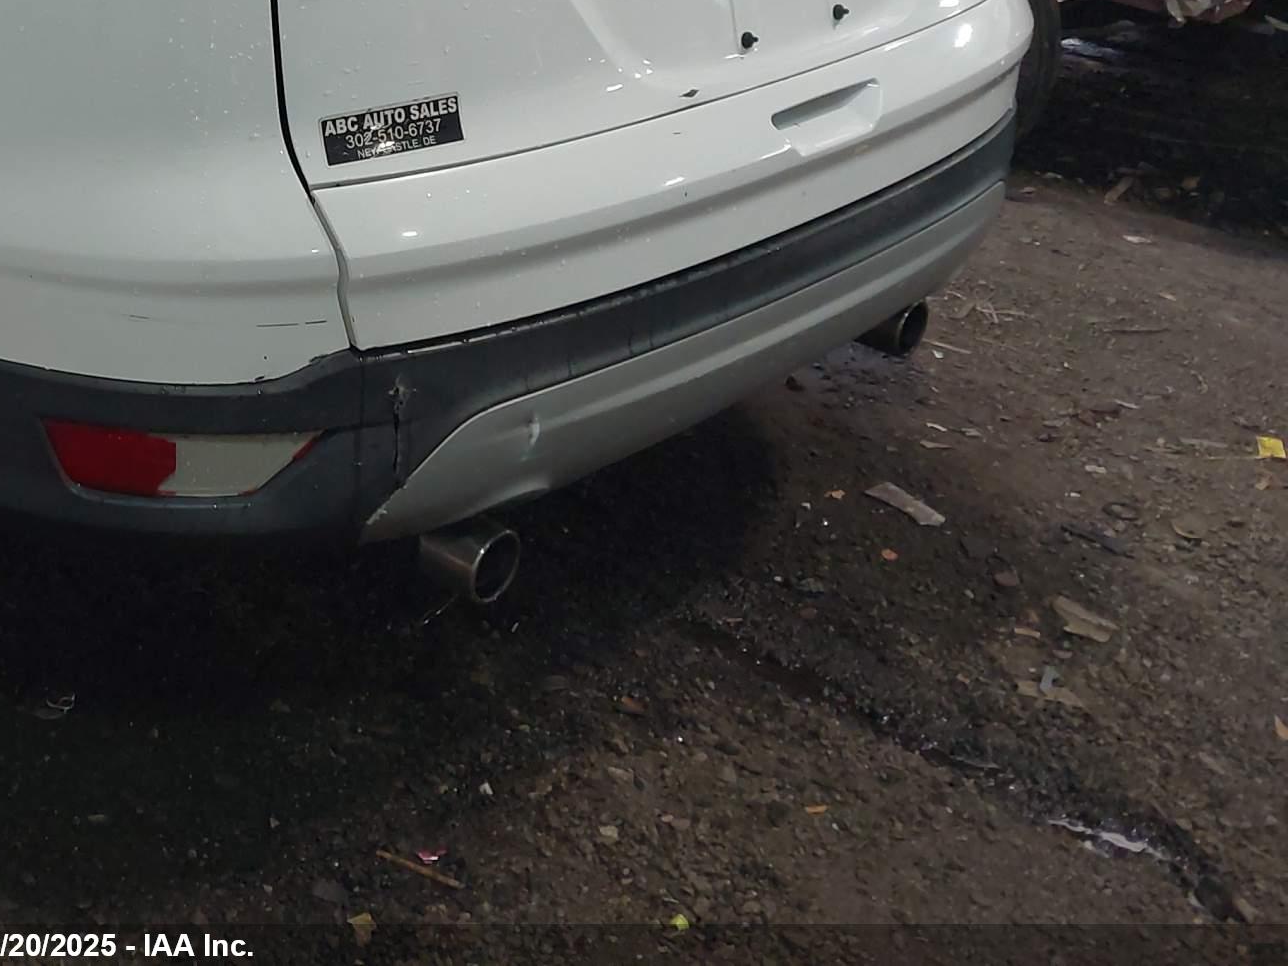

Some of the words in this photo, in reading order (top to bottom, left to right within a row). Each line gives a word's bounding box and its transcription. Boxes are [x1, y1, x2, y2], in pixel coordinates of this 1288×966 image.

[324, 116, 358, 136] ABC
[363, 107, 406, 130] AUTO
[410, 97, 457, 121] SALES
[345, 118, 441, 149] 302-510-6737
[423, 135, 437, 146] DE
